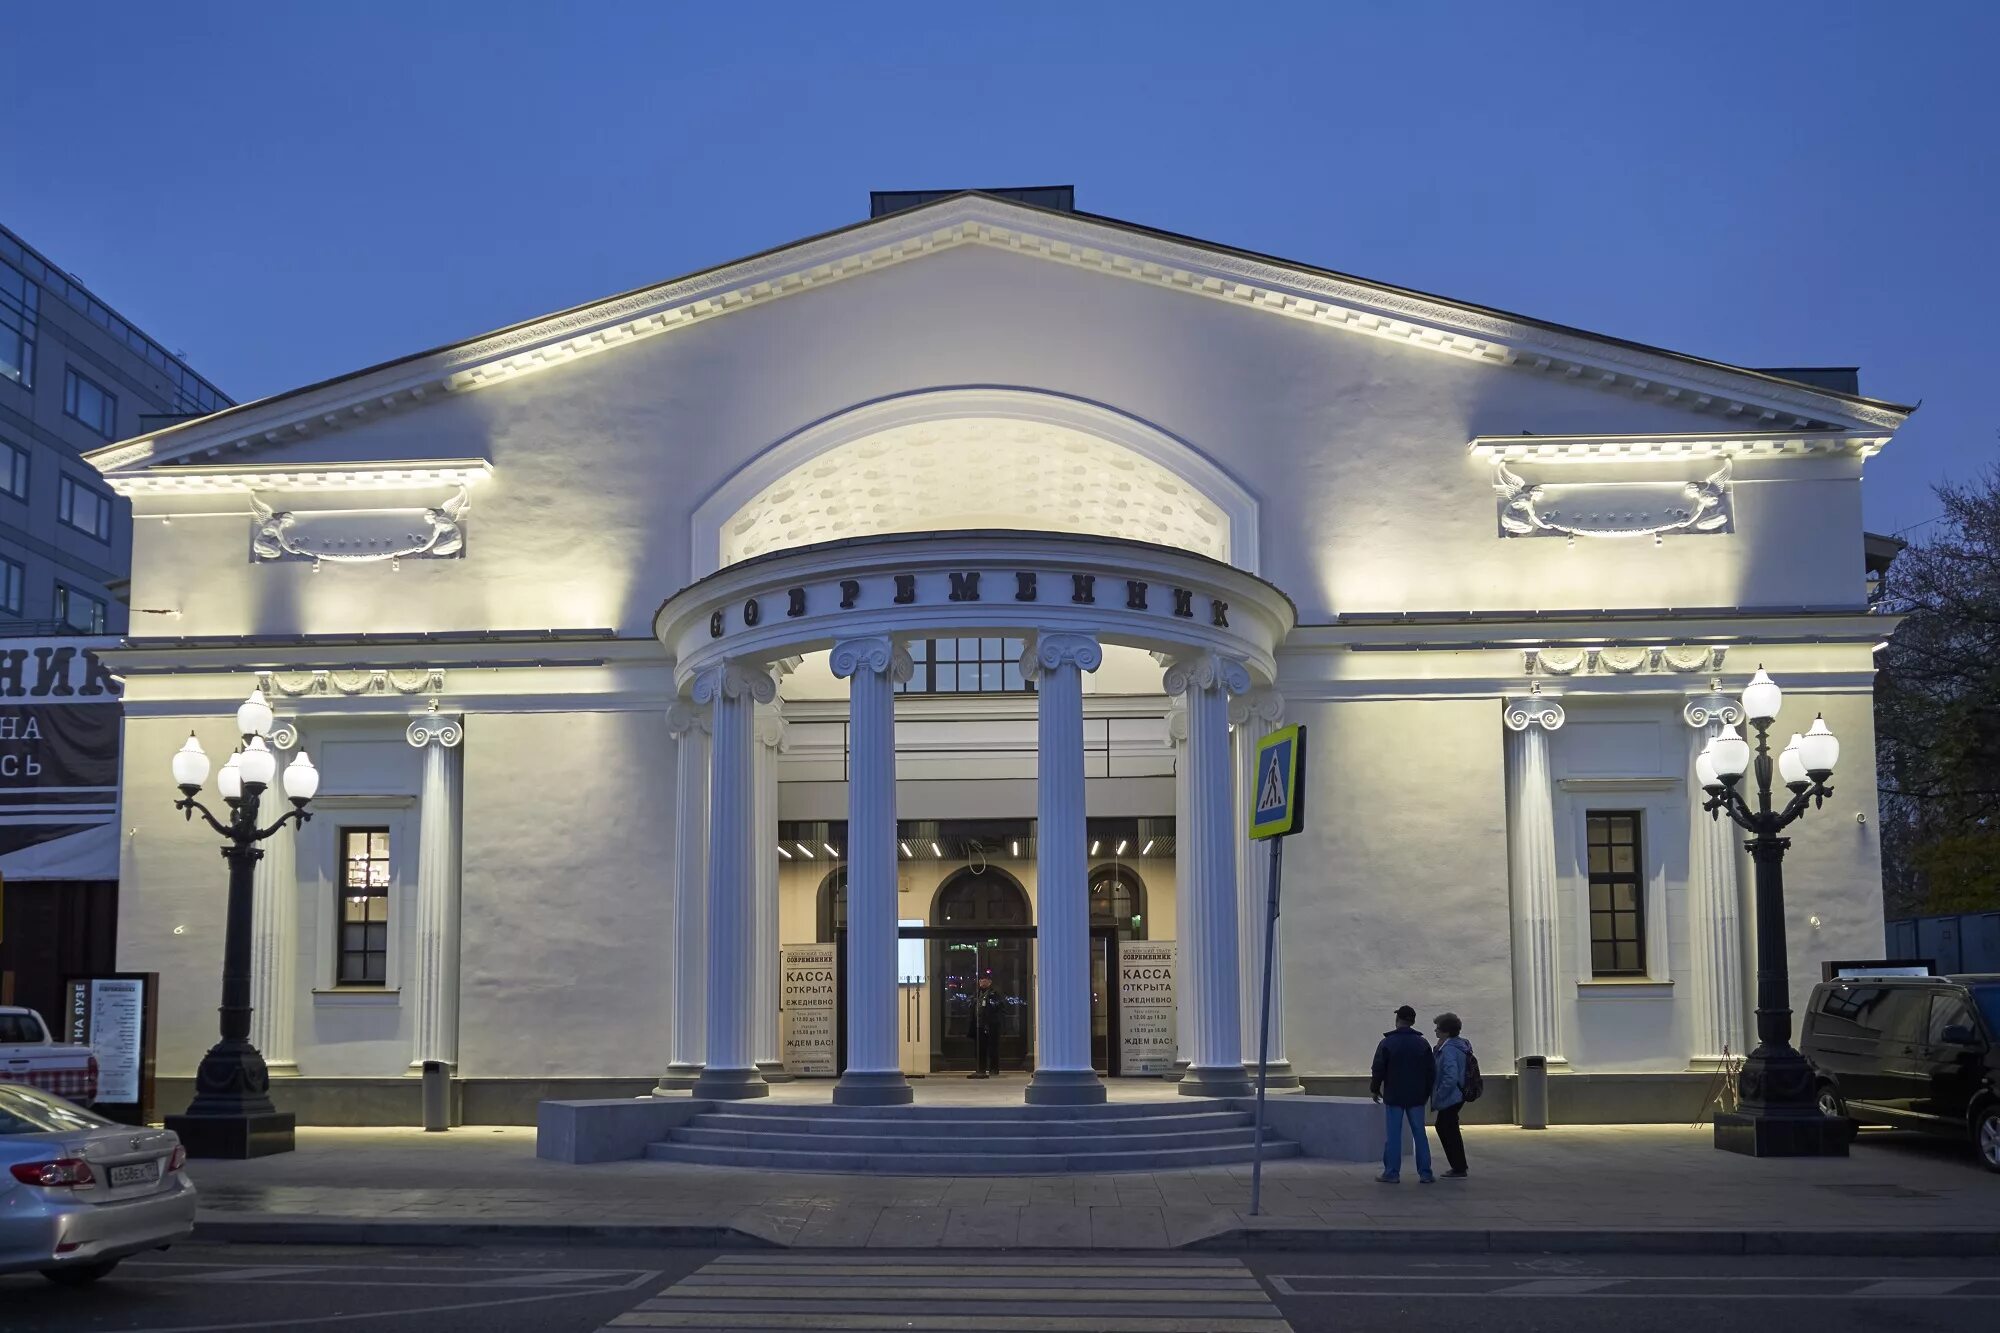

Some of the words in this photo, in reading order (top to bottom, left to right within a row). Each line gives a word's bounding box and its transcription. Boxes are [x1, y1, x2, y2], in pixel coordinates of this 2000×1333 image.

[709, 572, 1230, 638] СОВРЕМЕННИК
[1, 754, 42, 777] СЬ
[786, 971, 833, 982] КАССА
[1123, 969, 1171, 979] КАССА
[786, 986, 833, 994] ОТКРЫТА
[1123, 983, 1172, 991] ОТКРЫТА
[75, 983, 86, 1016] ЯУЗЕ
[74, 1018, 84, 1038] НА
[786, 1039, 812, 1047] ЖДЕМ
[1124, 1038, 1150, 1046] ЖДЕМ
[1152, 1037, 1173, 1045] ВАС!
